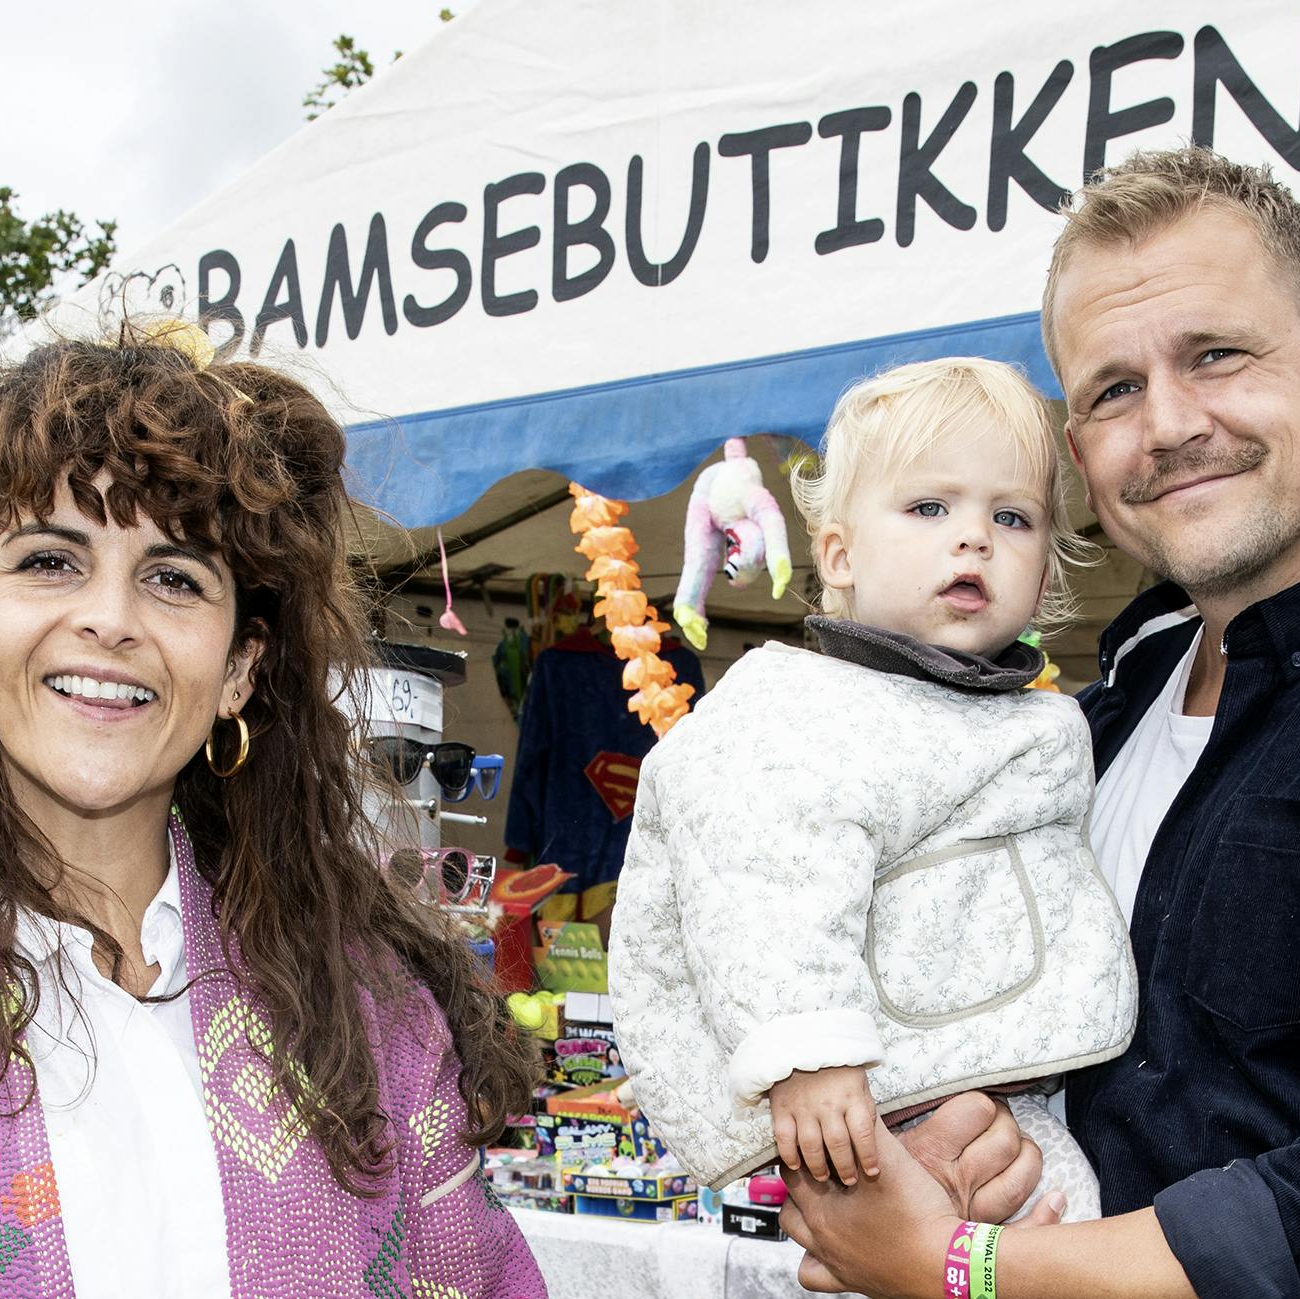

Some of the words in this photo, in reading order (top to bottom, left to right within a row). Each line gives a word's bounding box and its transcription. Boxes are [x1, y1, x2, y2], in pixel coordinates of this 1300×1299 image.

[984, 1225, 1000, 1263] FESTIVAL
[946, 1266, 967, 1297] 18+
[984, 1266, 993, 1293] 2022
